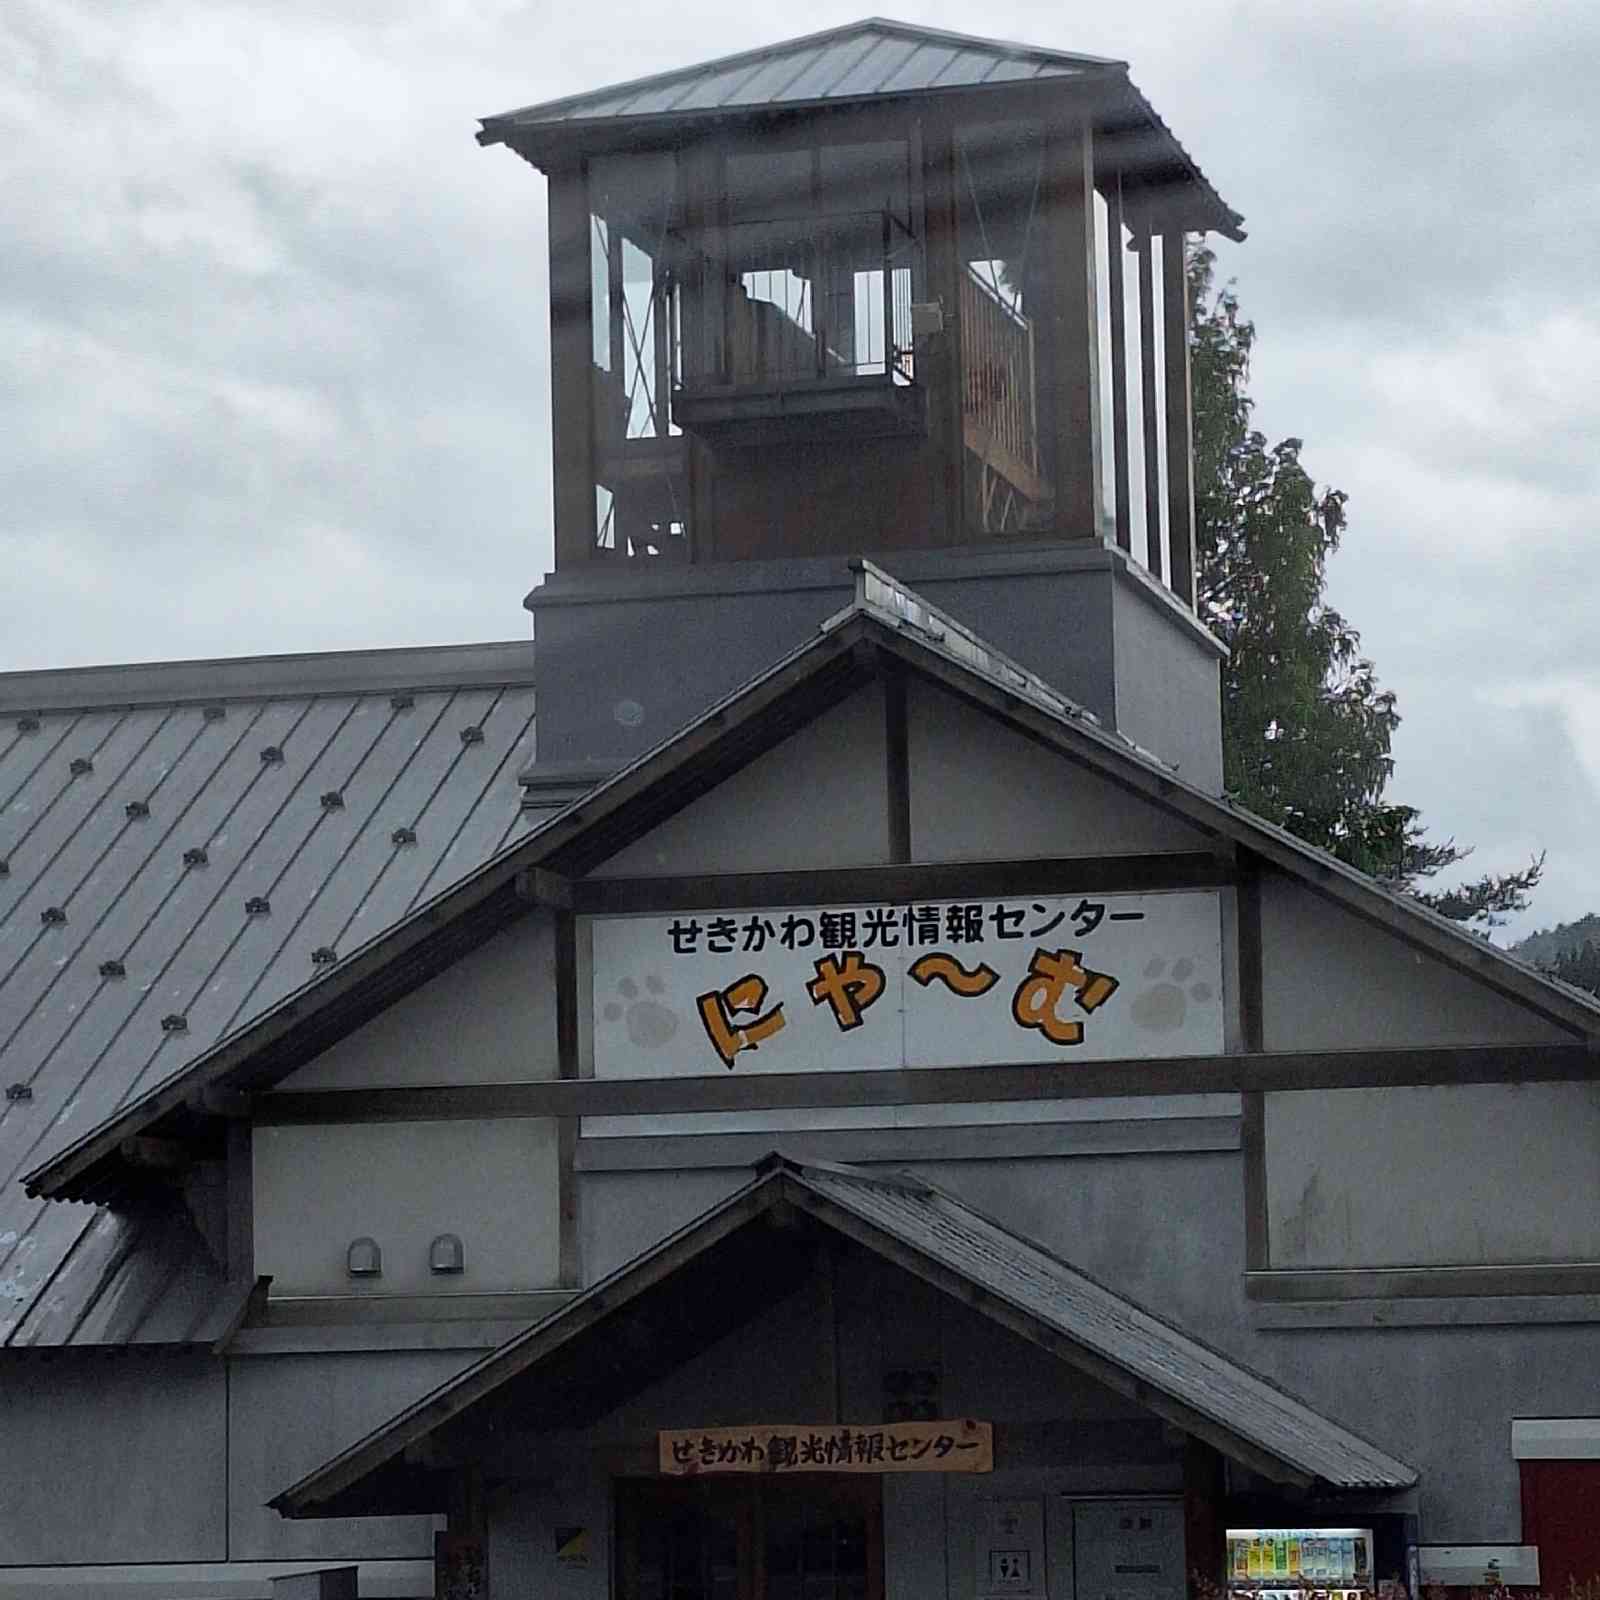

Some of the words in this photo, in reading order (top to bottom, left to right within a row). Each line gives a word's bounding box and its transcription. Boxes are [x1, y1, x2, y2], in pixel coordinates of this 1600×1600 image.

[667, 900, 1145, 955] せきかわ観光情報センター
[672, 1429, 979, 1465] せきかわ観光情報センター
